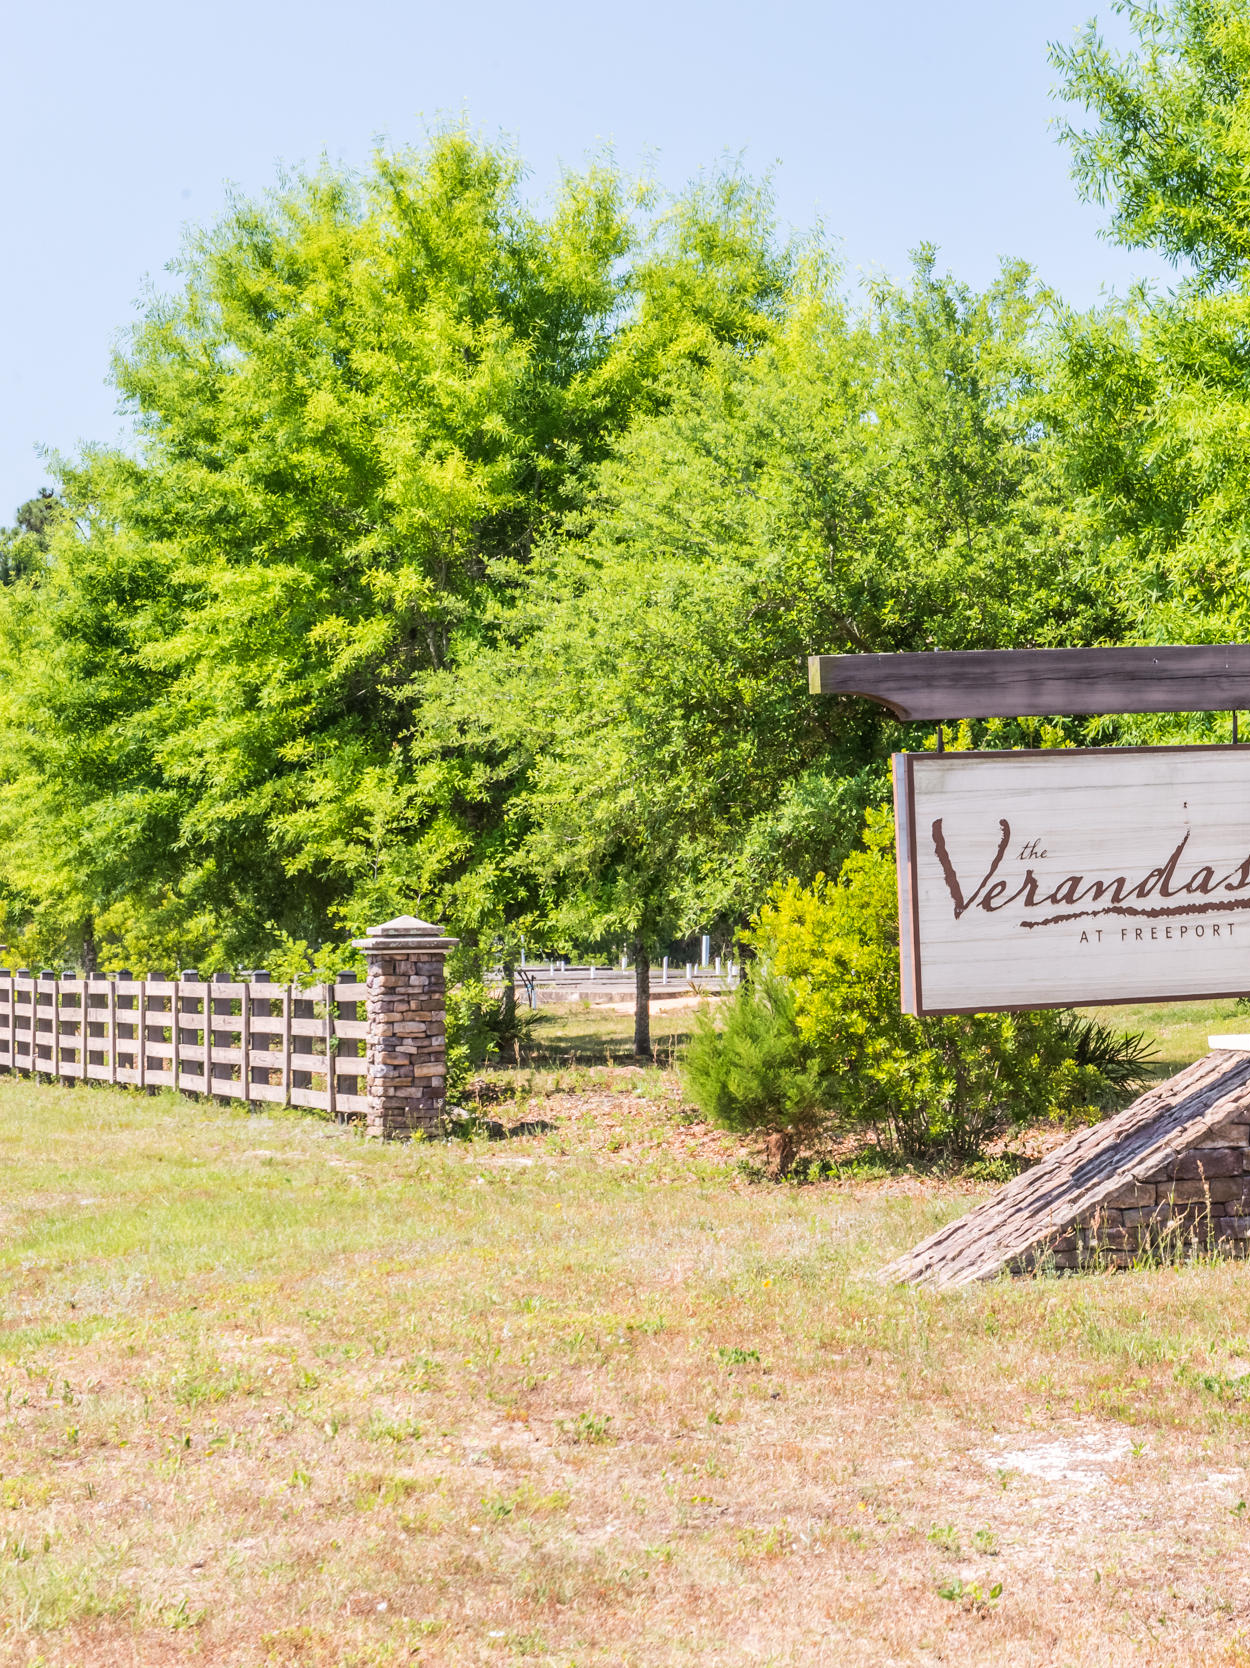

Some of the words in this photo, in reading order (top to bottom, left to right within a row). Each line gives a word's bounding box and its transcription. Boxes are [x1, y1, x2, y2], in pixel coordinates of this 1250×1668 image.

[1017, 838, 1048, 860] the
[1080, 930, 1104, 943] AT
[1121, 922, 1235, 942] FREEPORT
